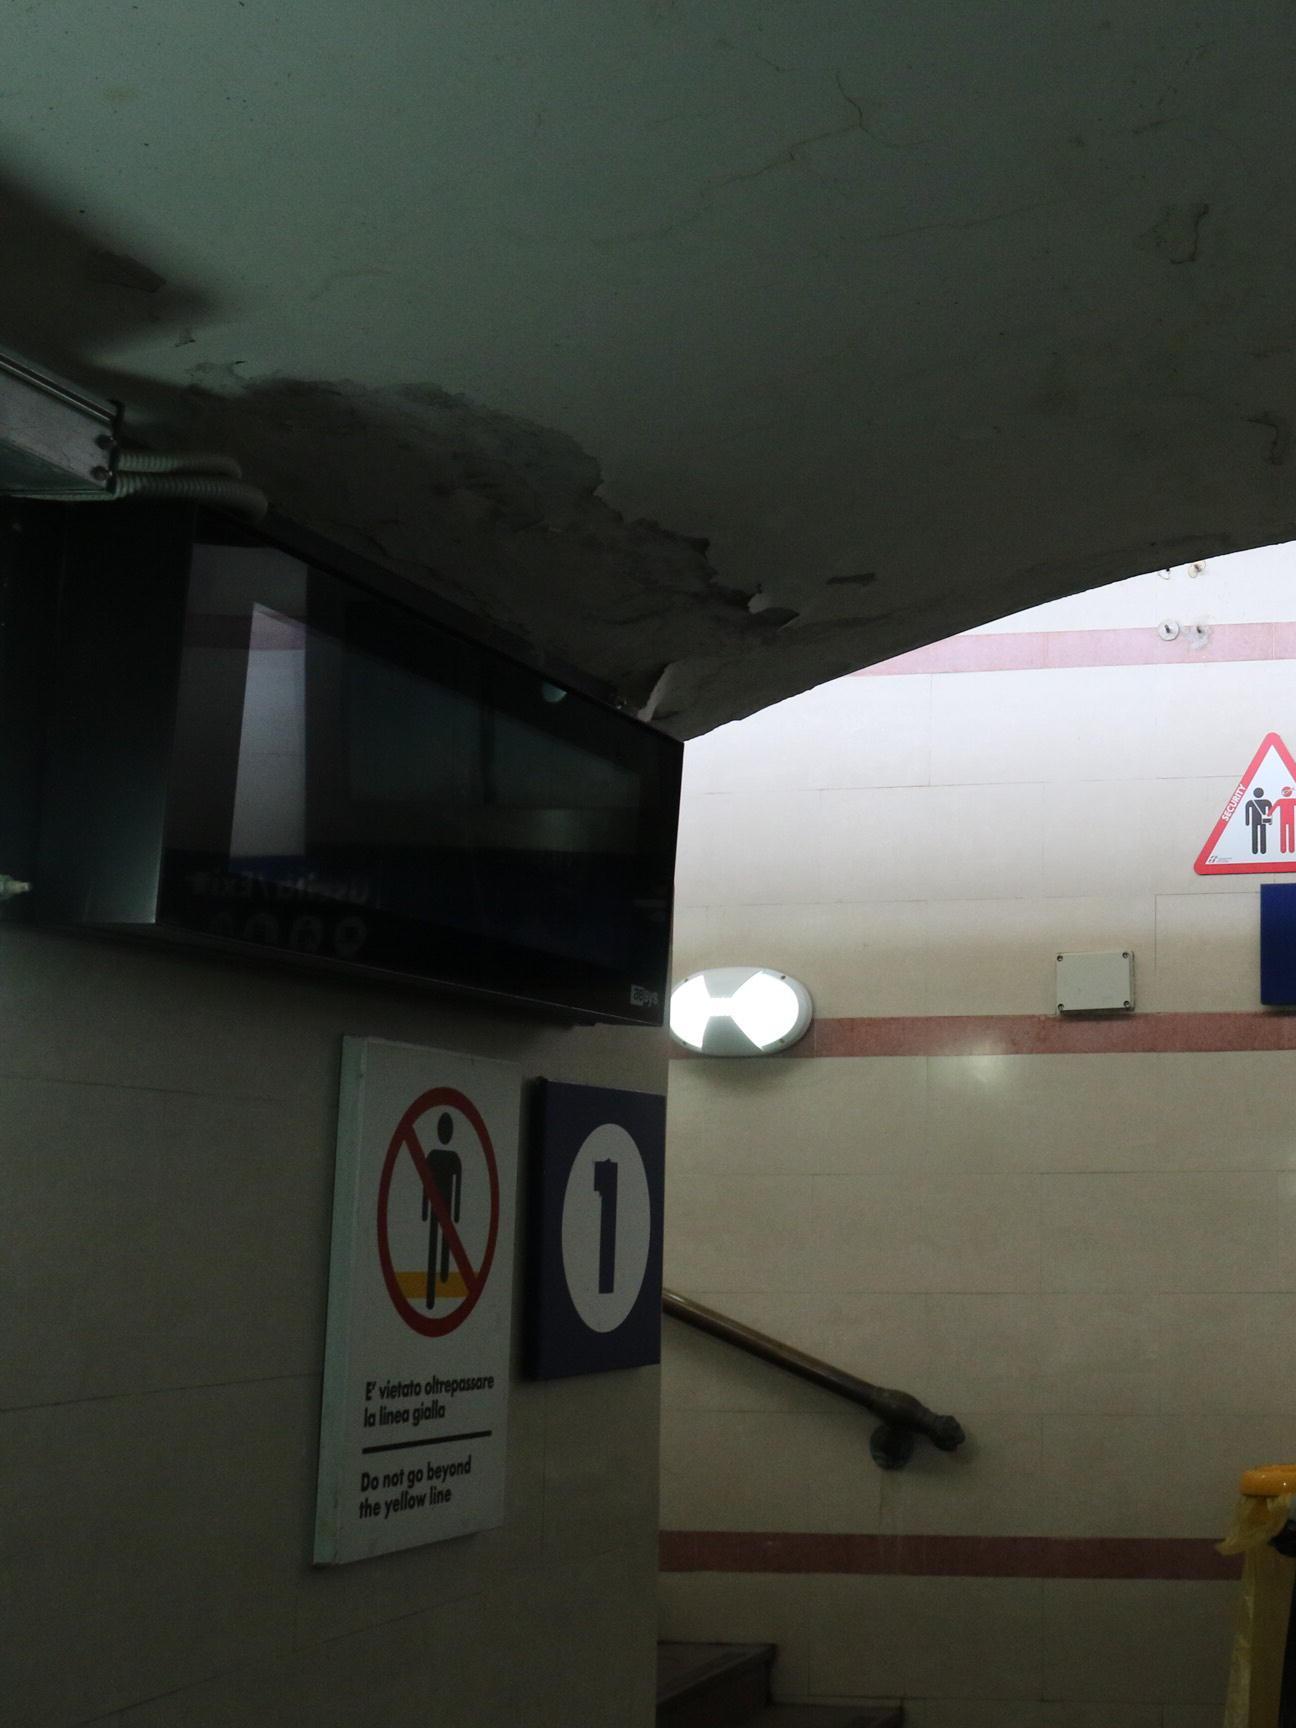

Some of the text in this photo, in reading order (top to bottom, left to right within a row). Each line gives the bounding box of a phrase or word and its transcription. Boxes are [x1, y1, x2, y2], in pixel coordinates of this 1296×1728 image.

[1222, 784, 1247, 822] SECURITY
[592, 1158, 618, 1294] 1
[379, 1379, 422, 1399] vietato
[425, 1375, 494, 1397] oltrepassare
[364, 1399, 446, 1427] la linea gialla
[361, 1454, 472, 1492] Do not go beyond
[359, 1485, 452, 1519] the yellow line
